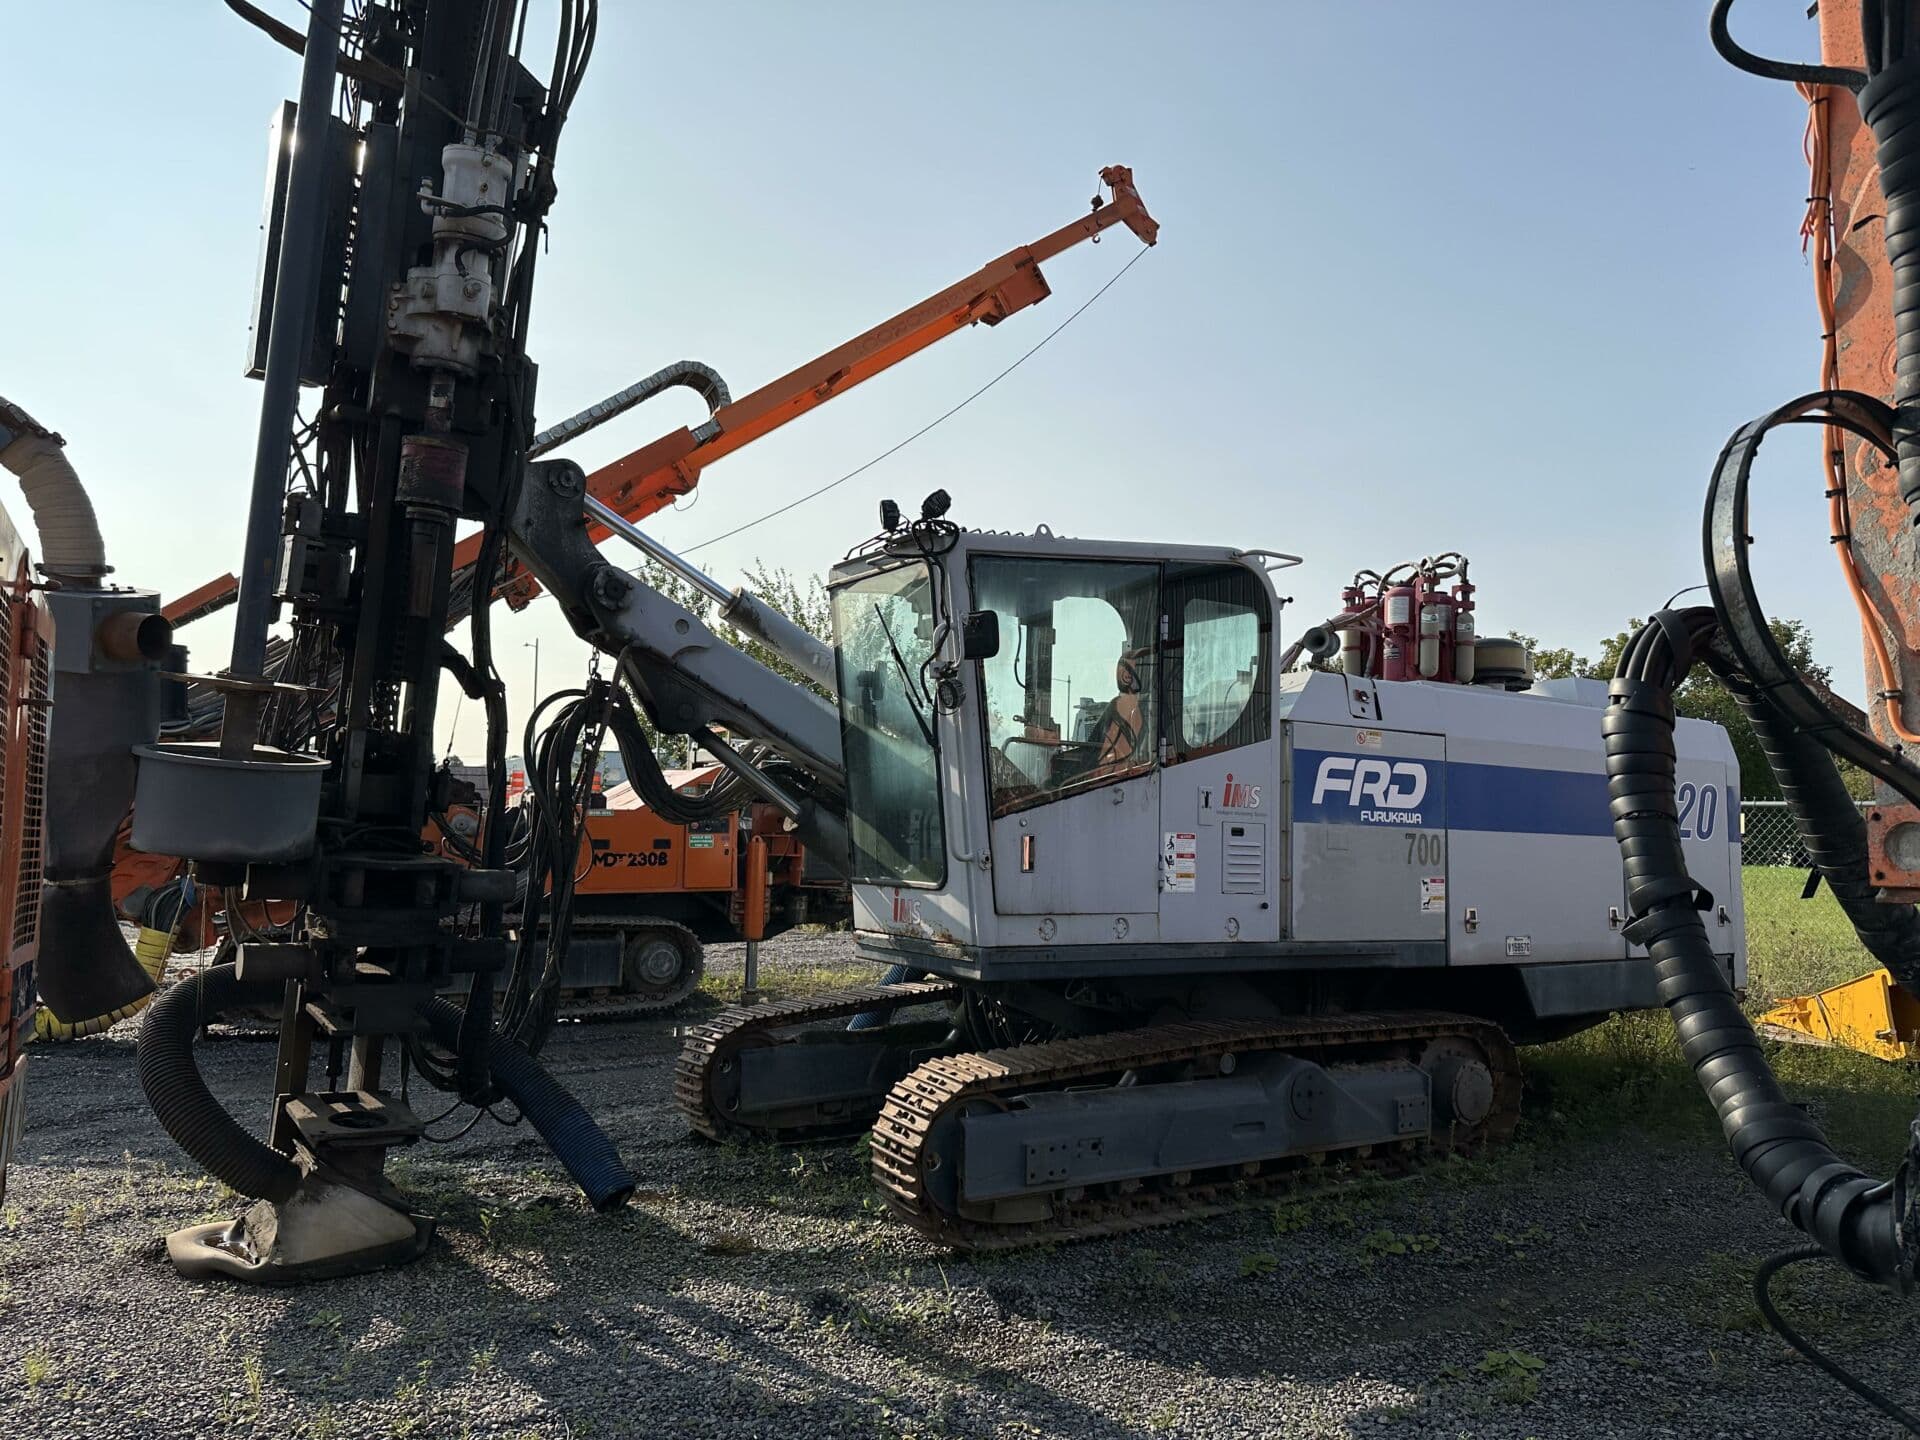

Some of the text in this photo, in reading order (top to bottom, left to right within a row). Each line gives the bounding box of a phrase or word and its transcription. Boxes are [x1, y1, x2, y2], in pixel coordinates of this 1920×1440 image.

[1311, 756, 1428, 809] FRD
[1360, 810, 1422, 825] FURUKAWA
[1405, 832, 1441, 866] 700
